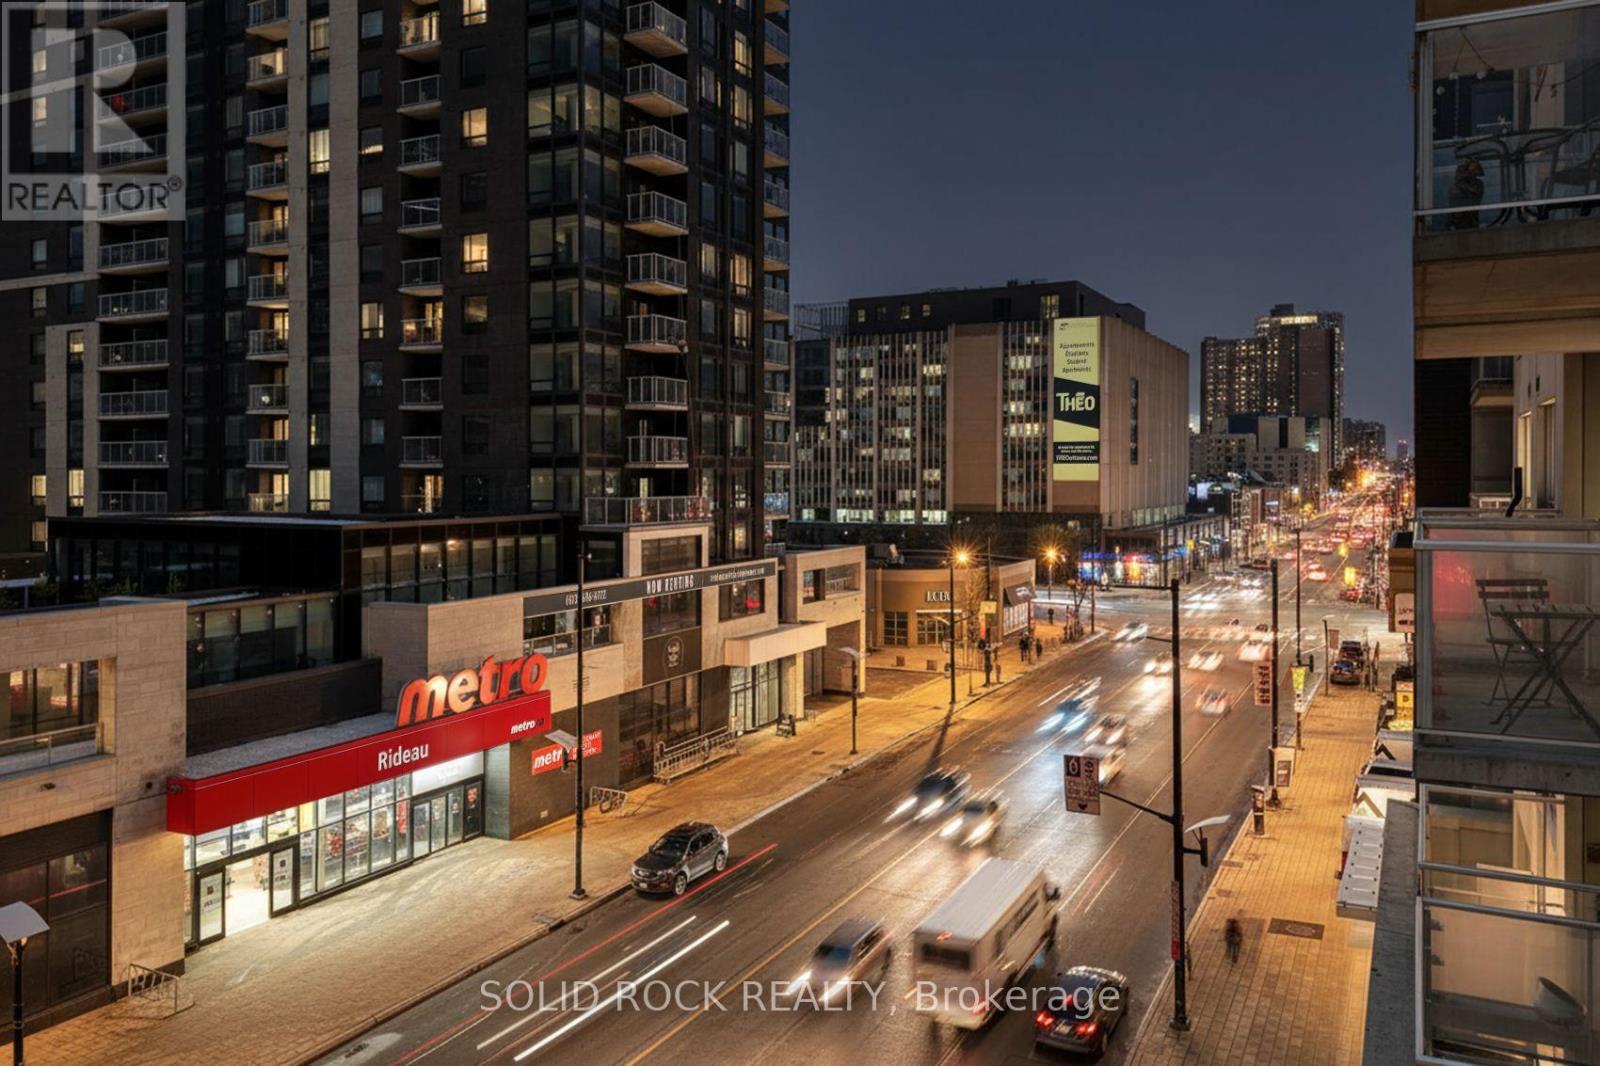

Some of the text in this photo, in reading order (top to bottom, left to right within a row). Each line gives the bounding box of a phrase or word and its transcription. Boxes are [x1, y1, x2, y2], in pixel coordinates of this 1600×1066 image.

[646, 578, 662, 595] NOW
[665, 574, 694, 592] RENTING
[396, 652, 549, 728] metro
[377, 743, 430, 771] Rideau
[534, 749, 566, 769] metr
